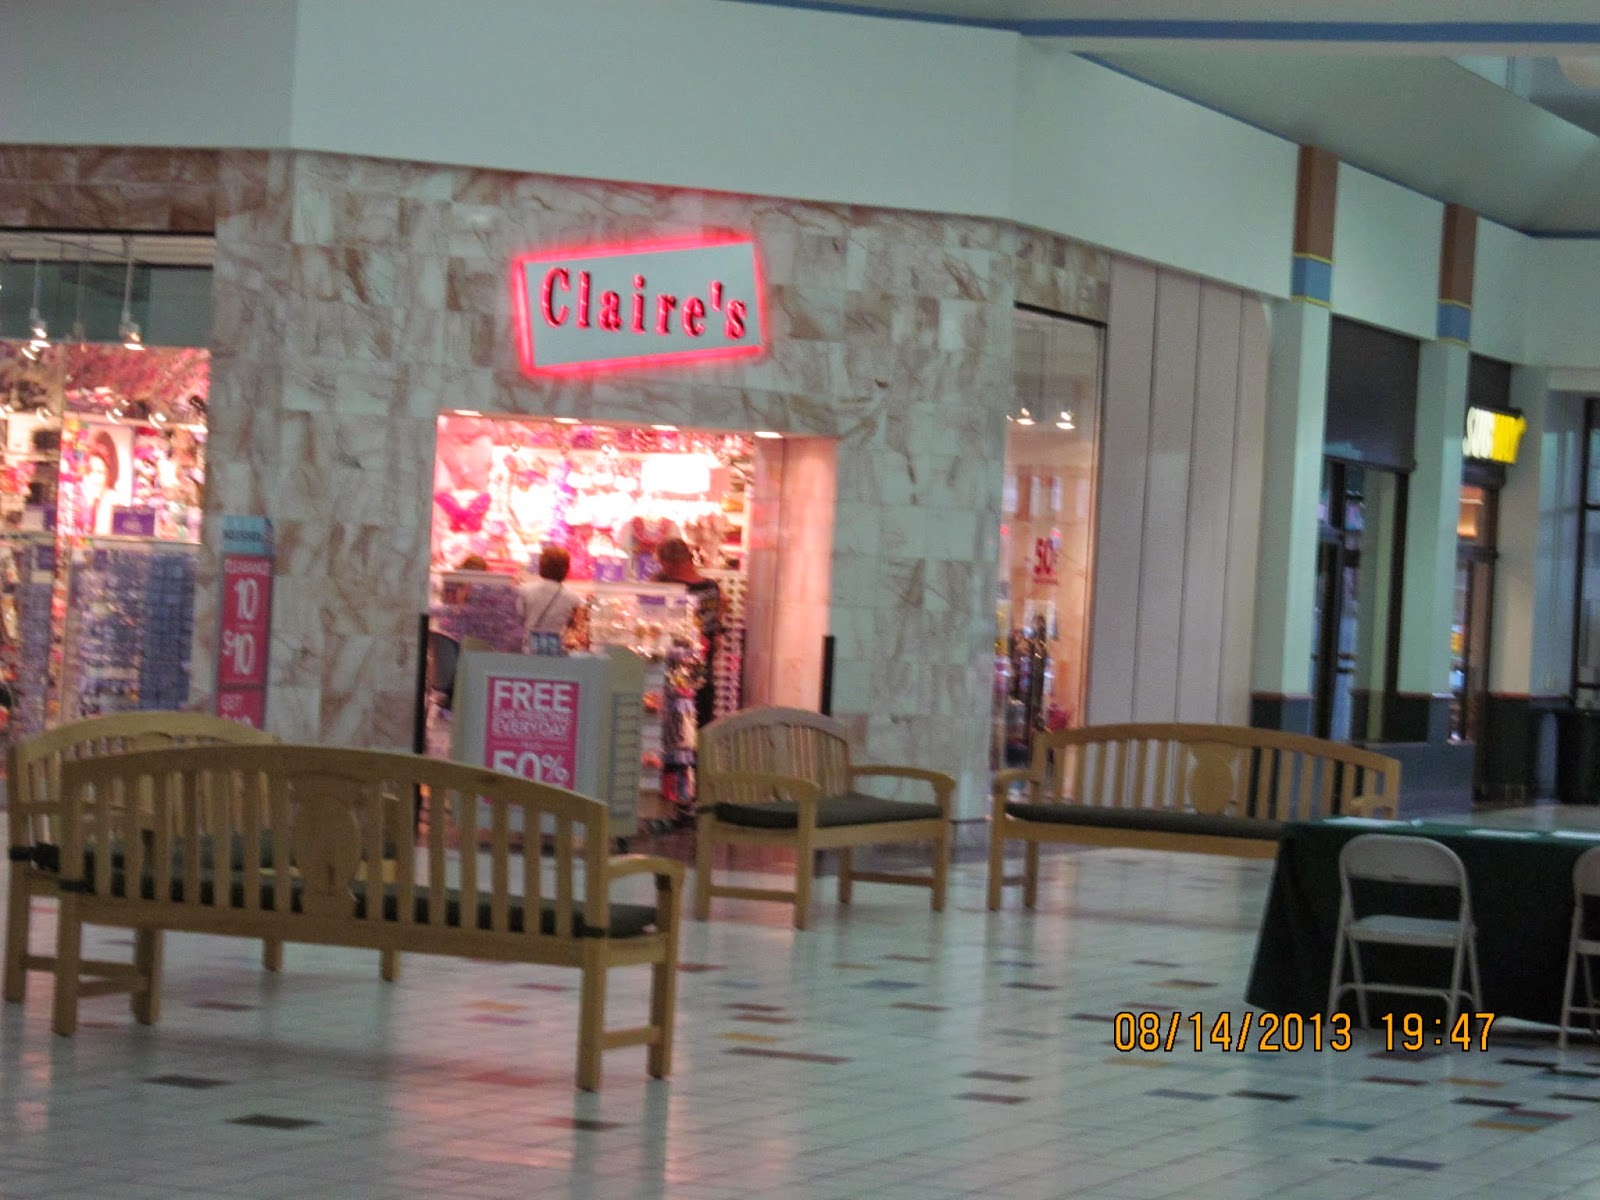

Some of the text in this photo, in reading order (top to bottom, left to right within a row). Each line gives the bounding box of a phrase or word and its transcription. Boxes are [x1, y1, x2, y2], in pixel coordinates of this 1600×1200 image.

[540, 267, 747, 340] Claire's
[233, 577, 261, 621] 10
[493, 680, 572, 713] FREE
